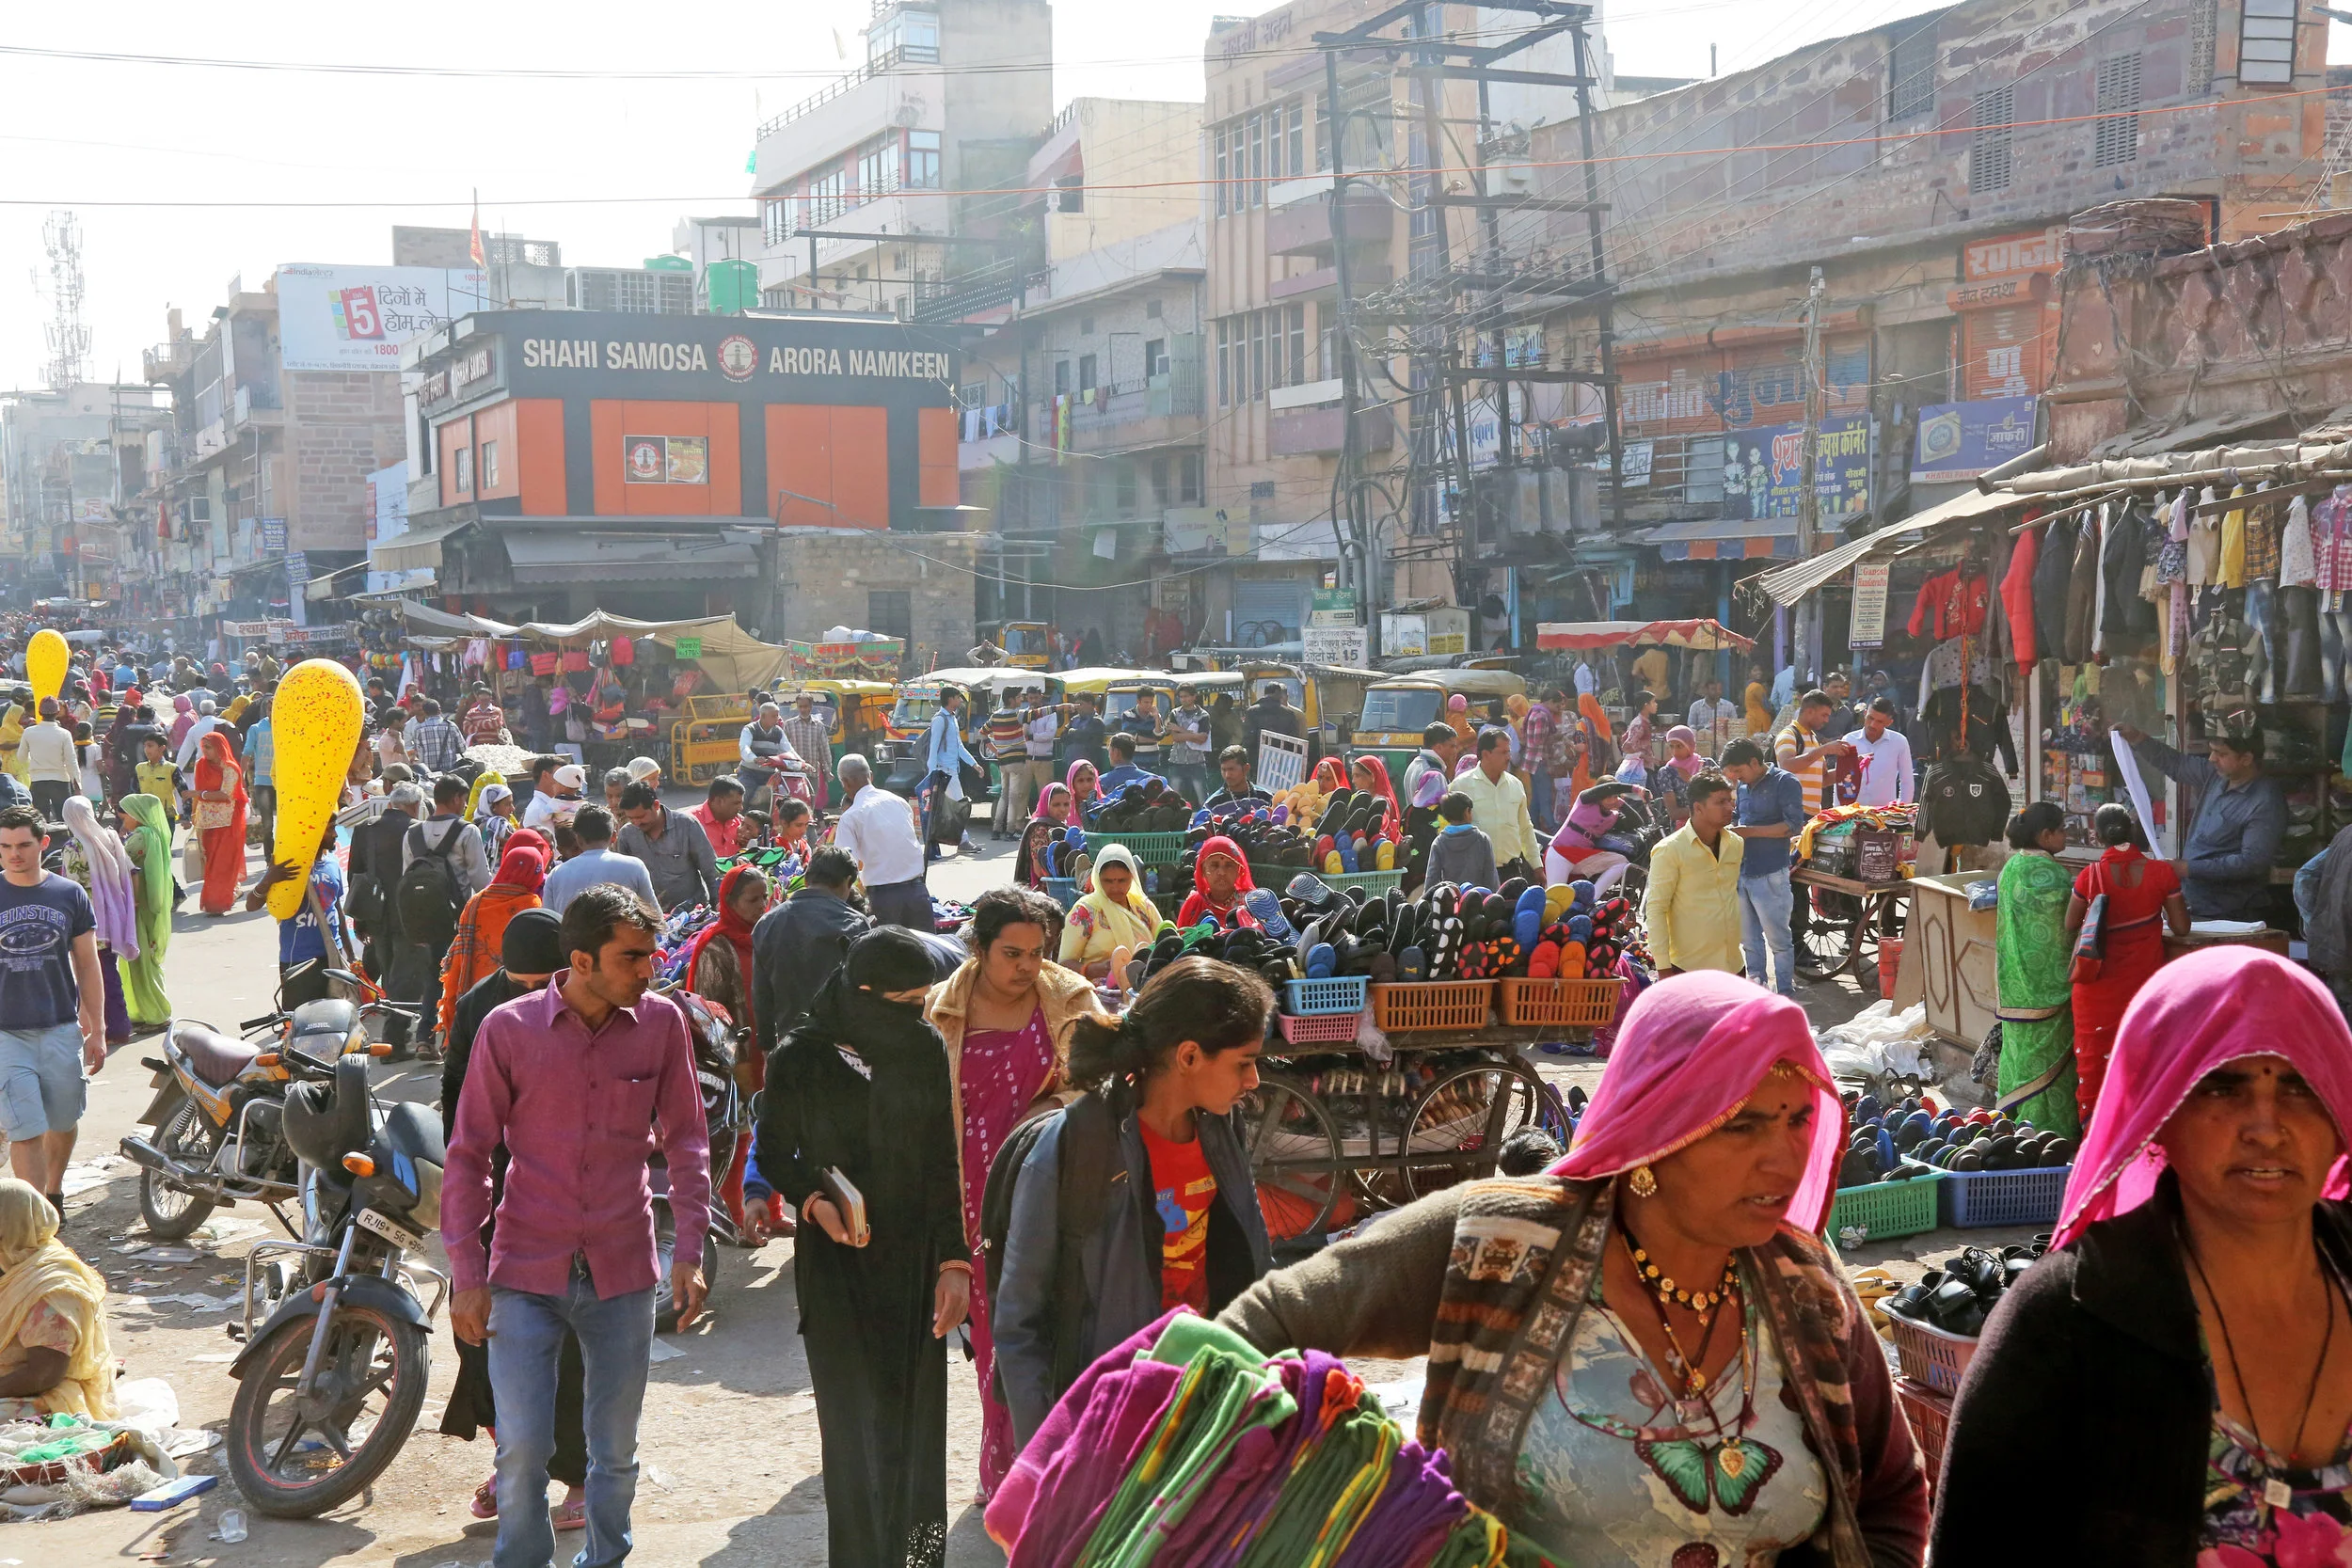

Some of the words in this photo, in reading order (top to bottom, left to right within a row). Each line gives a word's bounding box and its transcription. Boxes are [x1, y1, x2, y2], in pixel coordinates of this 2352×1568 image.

[350, 298, 375, 335] 5
[377, 286, 411, 307] दिनों
[414, 286, 427, 307] में
[384, 309, 414, 331] होम
[374, 344, 399, 356] 1800
[523, 339, 597, 368] SHAHI
[606, 341, 708, 371] SAMOSA
[769, 346, 842, 375] ARORA
[850, 349, 949, 379] NAMKEEN
[1343, 649, 1359, 661] 15
[310, 873, 334, 884] MR.
[393, 1230, 406, 1243] SG
